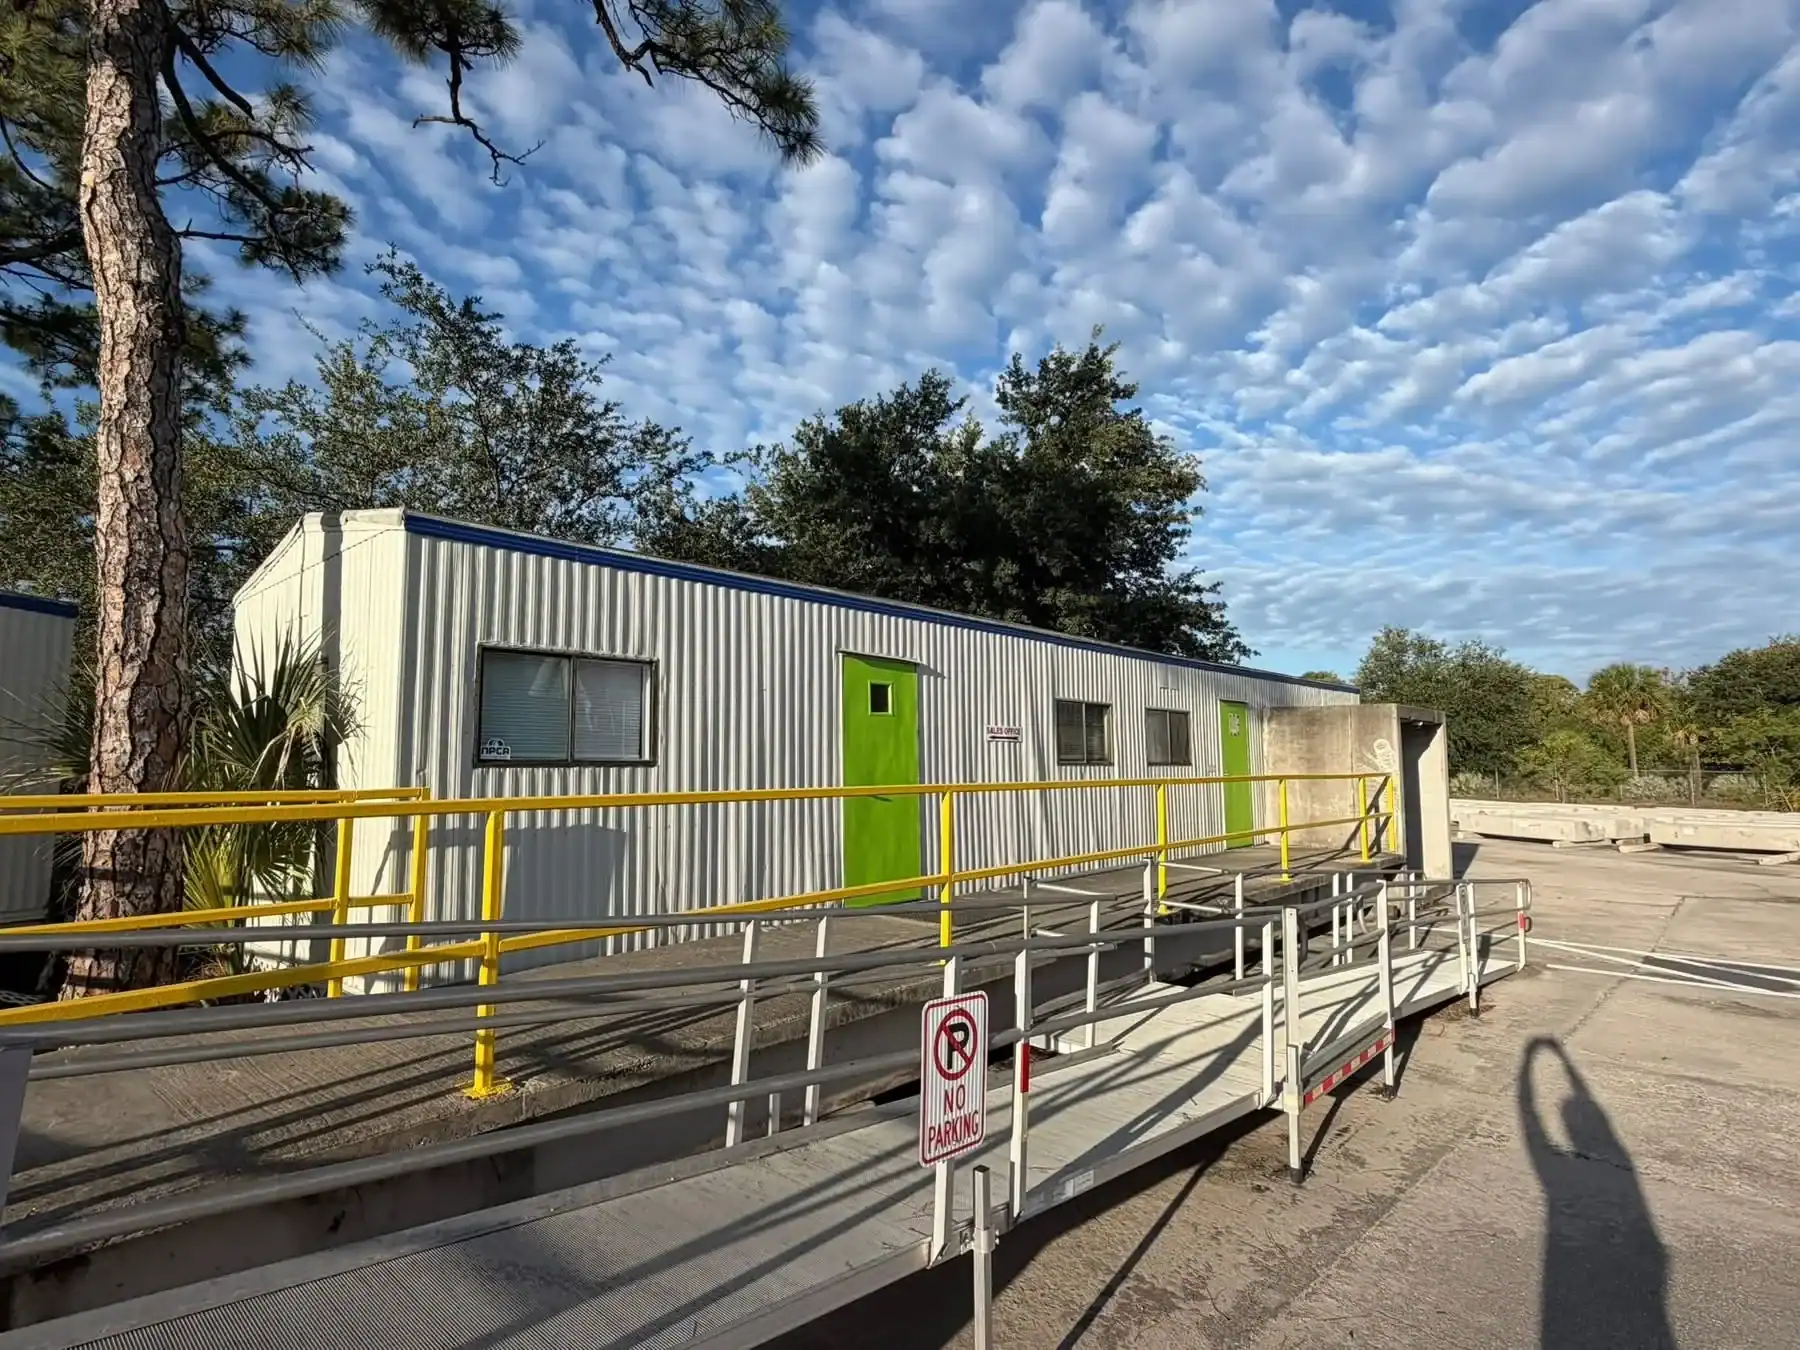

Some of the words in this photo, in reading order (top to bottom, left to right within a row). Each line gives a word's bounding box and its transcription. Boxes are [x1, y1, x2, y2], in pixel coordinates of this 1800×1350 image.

[986, 726, 1003, 735] SALES
[1004, 727, 1021, 736] OFFICE
[946, 1022, 970, 1070] P
[943, 1084, 966, 1114] NO
[928, 1111, 979, 1153] PARKING
